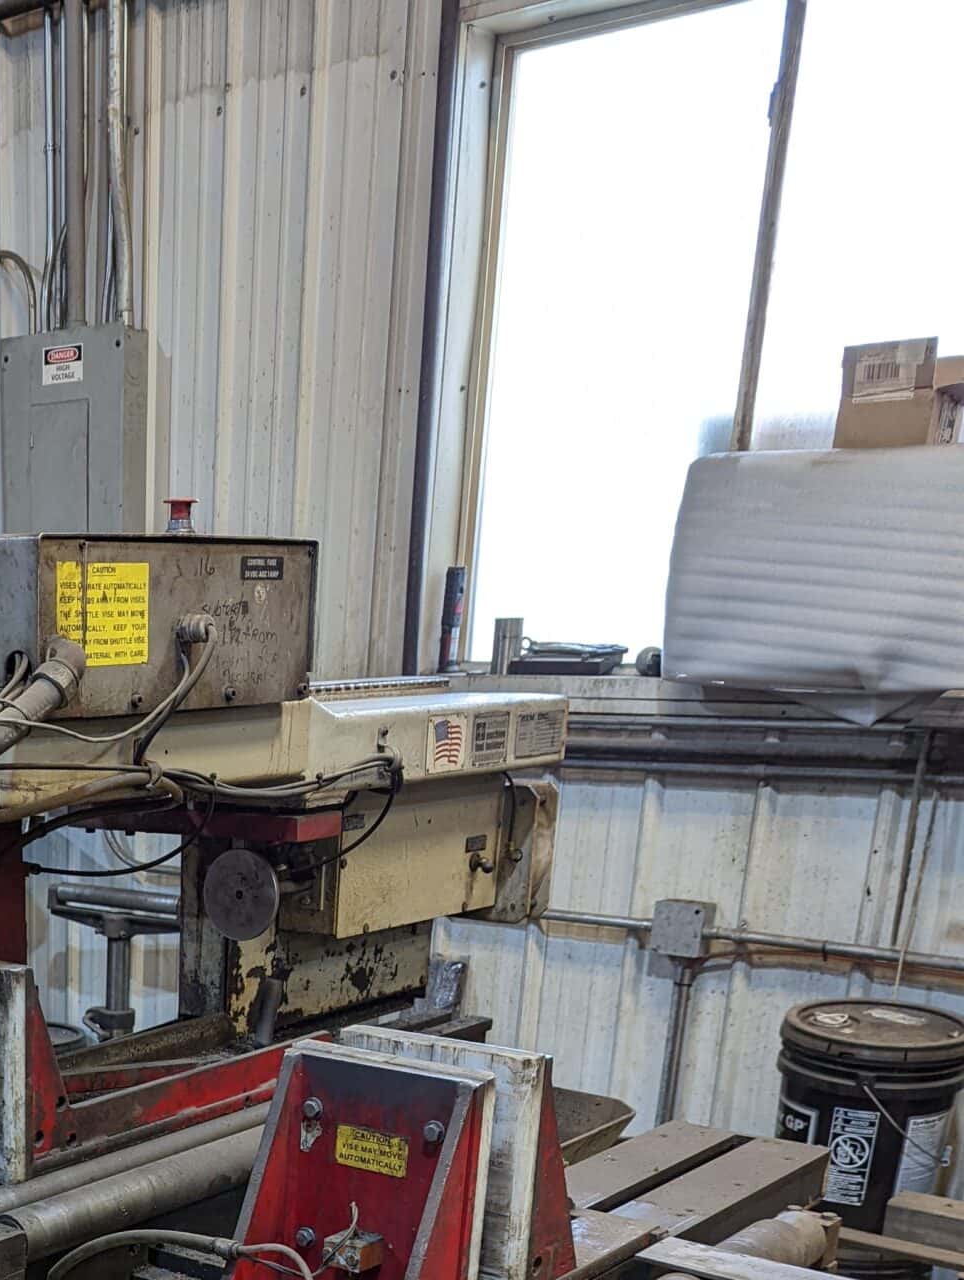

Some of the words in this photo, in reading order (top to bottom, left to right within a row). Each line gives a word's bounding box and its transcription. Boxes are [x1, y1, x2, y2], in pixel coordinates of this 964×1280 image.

[50, 350, 76, 361] DANGER
[51, 371, 76, 381] VOLTAGE
[92, 566, 117, 574] CAUTION
[102, 582, 146, 591] AUTOMATICALLY
[114, 596, 129, 604] FROM
[101, 610, 115, 618] VISE
[132, 623, 146, 631] YOUR
[109, 636, 133, 645] SHUTTLE
[354, 1130, 391, 1144] CAUTION
[342, 1142, 360, 1152] VISE
[361, 1145, 377, 1154] MAY
[338, 1151, 403, 1172] AUTOMATICALLY
